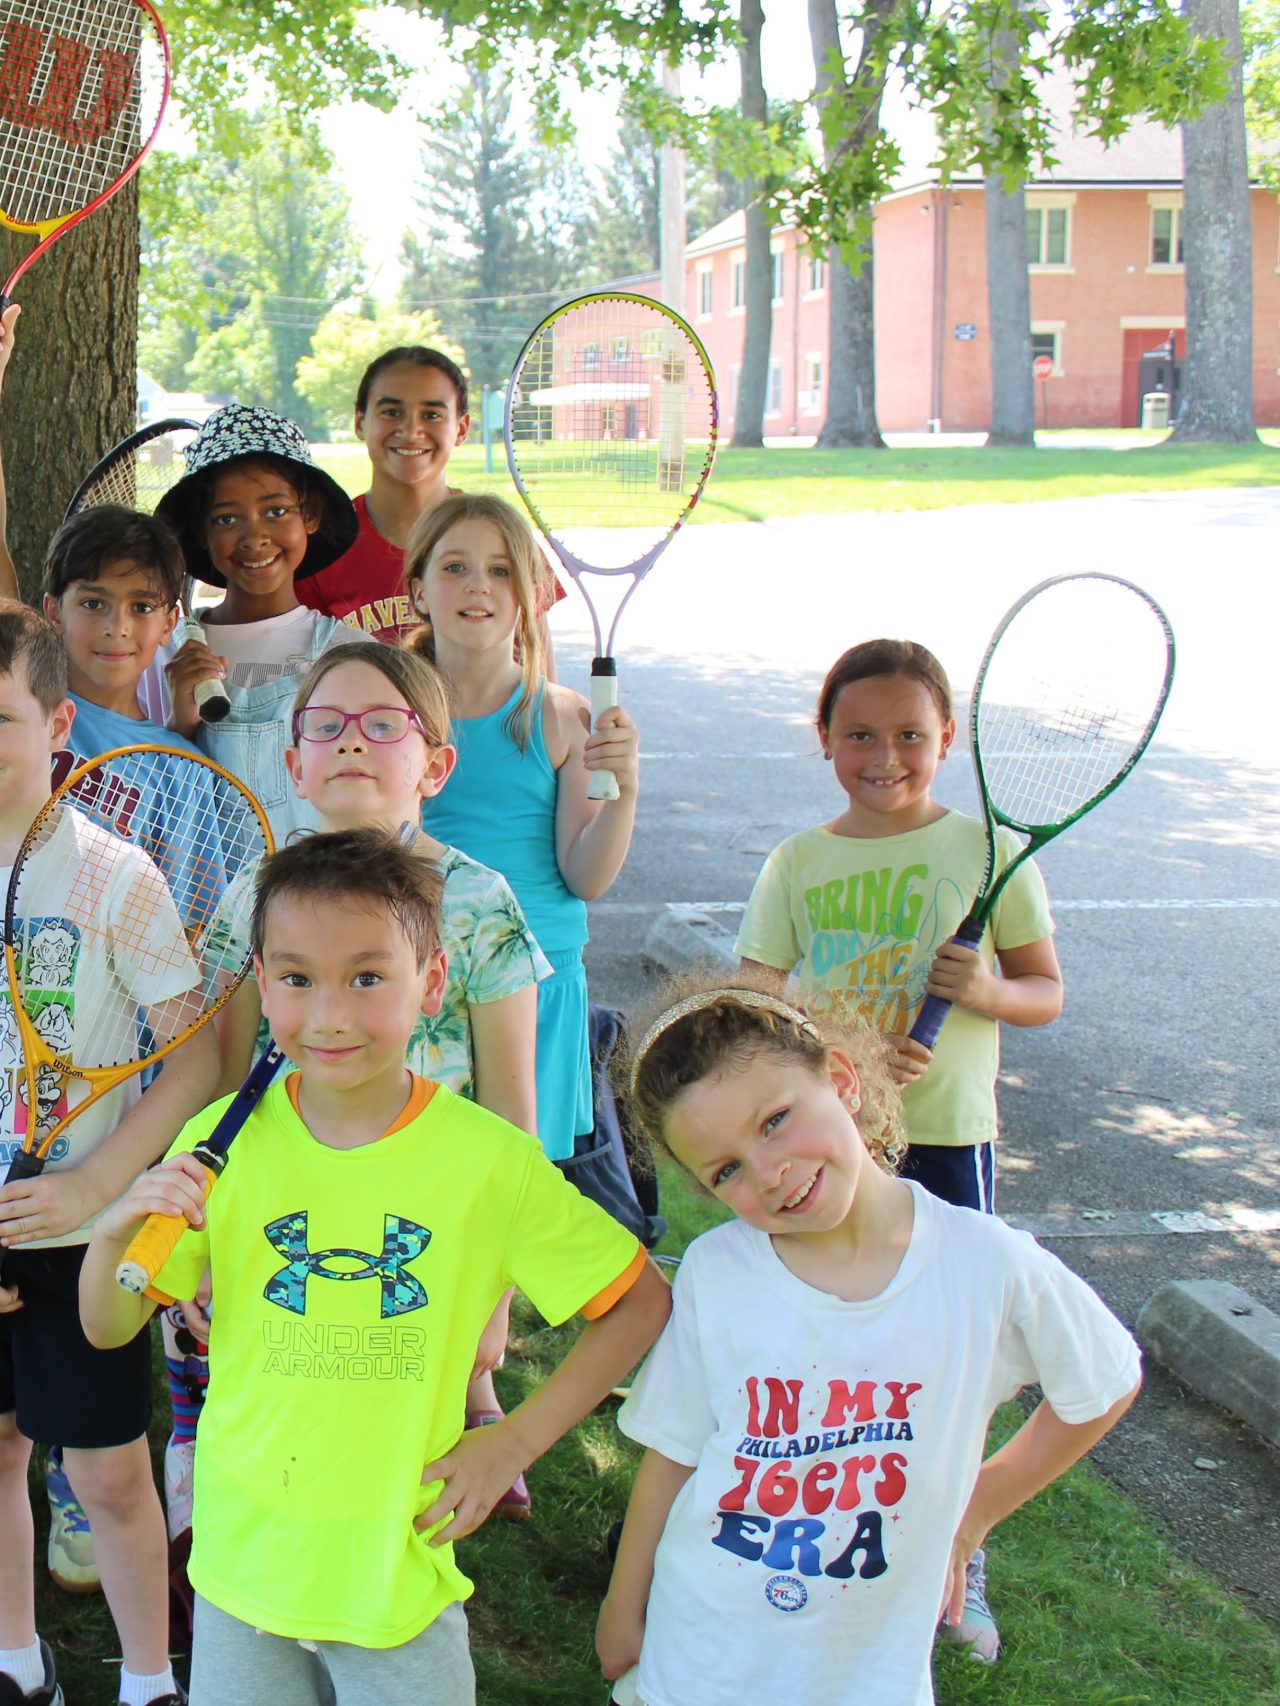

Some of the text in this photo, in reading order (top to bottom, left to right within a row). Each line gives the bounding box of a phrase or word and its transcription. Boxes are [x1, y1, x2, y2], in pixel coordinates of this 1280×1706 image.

[343, 595, 421, 634] HAVE
[805, 863, 928, 941] BRING
[845, 943, 913, 986] THE
[53, 1059, 84, 1078] Wilson
[262, 1320, 427, 1357] UNDER
[262, 1351, 426, 1382] ARMOUR
[745, 1376, 923, 1438] IN MY
[736, 1422, 914, 1458] PHILADELPHIA
[718, 1452, 908, 1517] 76ers
[711, 1510, 888, 1580] ERA
